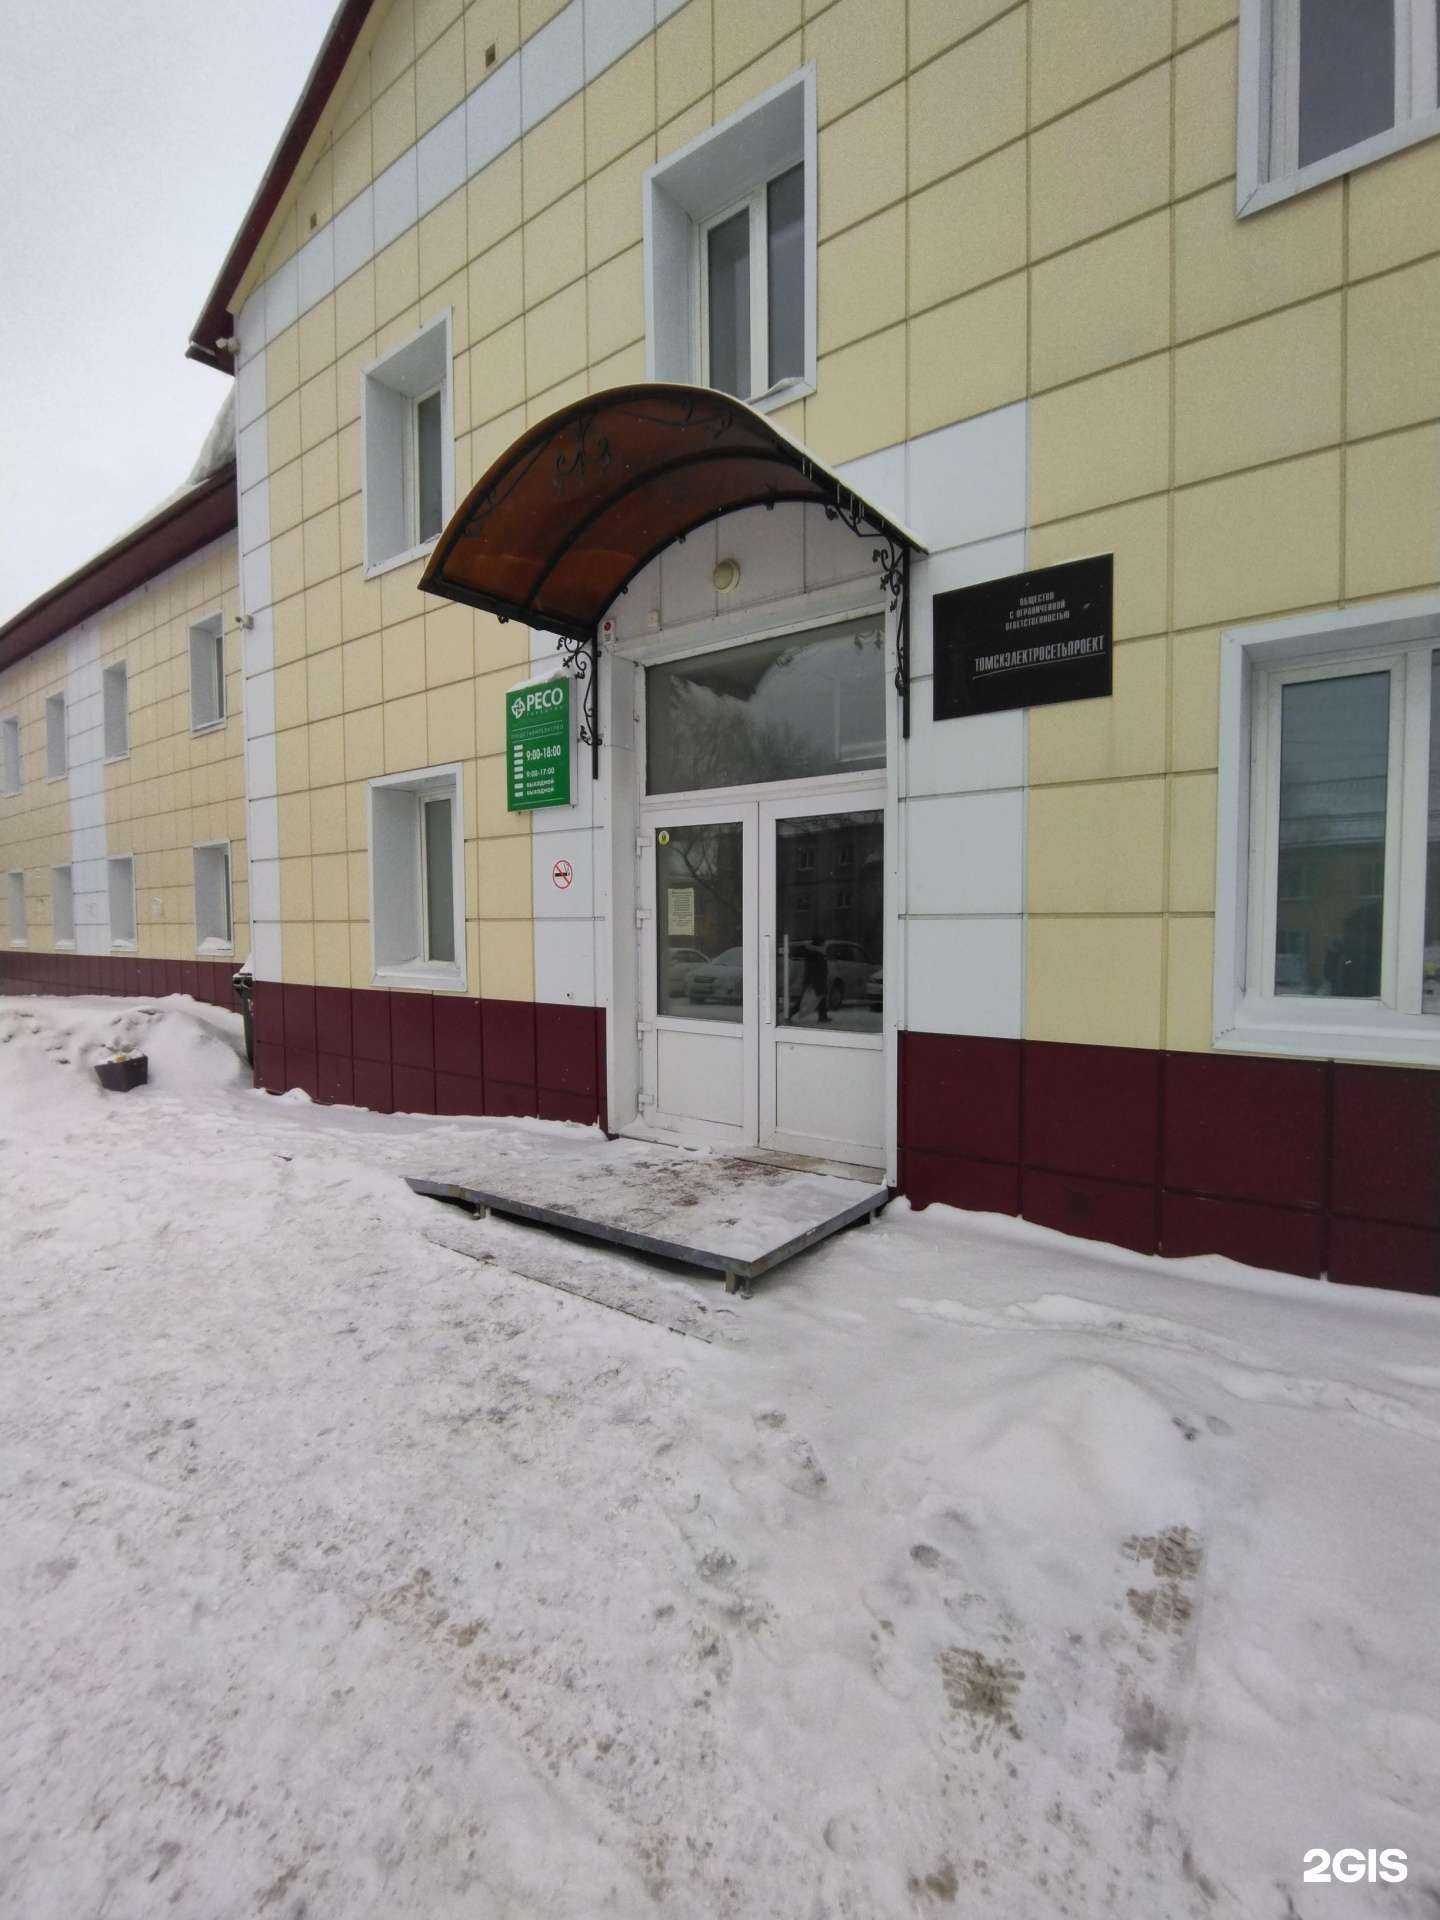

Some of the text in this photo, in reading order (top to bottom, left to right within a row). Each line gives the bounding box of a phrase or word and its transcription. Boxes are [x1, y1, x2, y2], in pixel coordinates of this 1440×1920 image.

[1016, 599, 1066, 618] ОГРАНИЧЕННОЙ
[1019, 592, 1055, 607] ОБЩЕСТВО
[1005, 610, 1070, 632] ОТВЕТСТВЕННОСТЬЮ
[975, 635, 1104, 671] ТОМСКЭЛЕКТРОСЕТЬПРОЕКТ
[527, 687, 564, 712] РЕСО
[526, 745, 561, 760] 9:00-18:00
